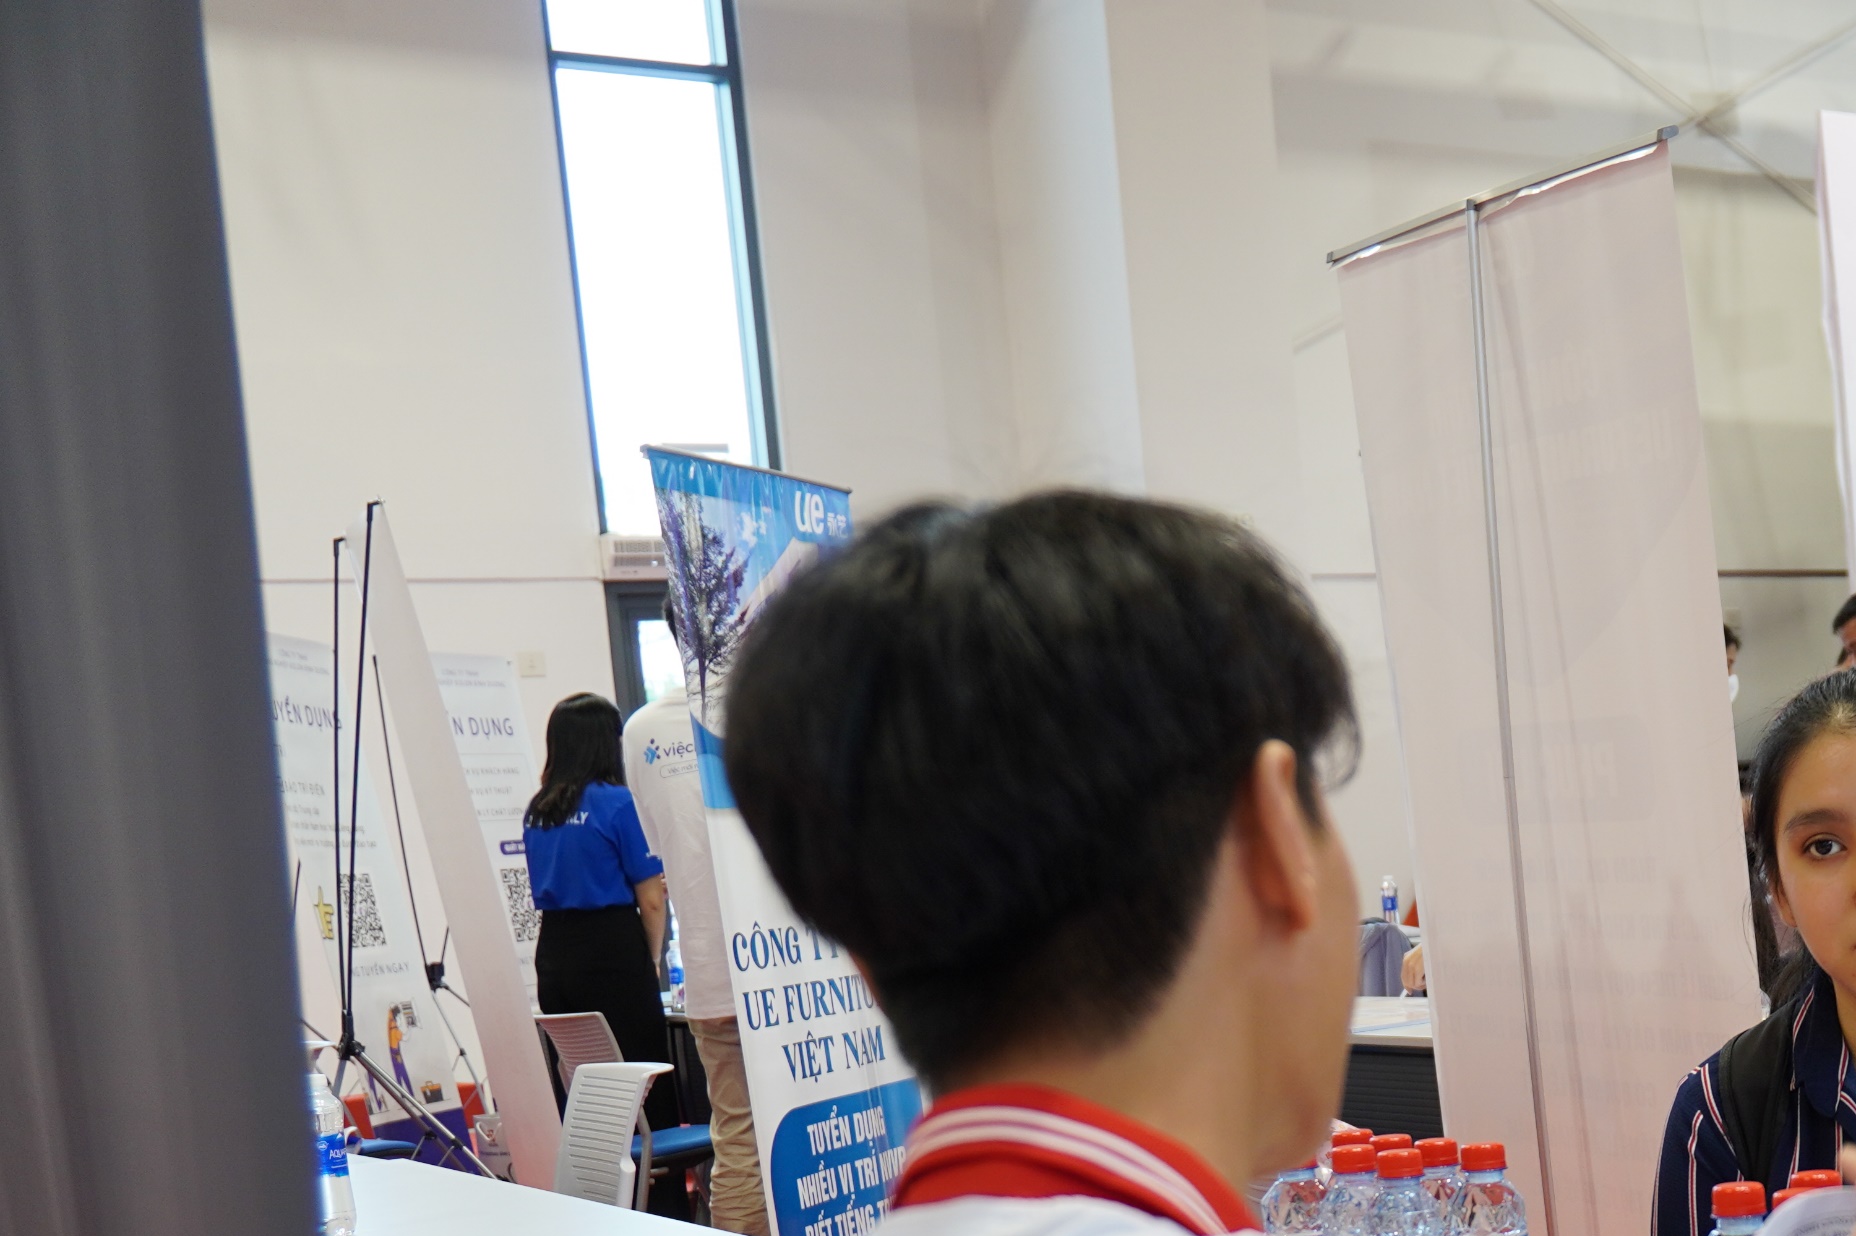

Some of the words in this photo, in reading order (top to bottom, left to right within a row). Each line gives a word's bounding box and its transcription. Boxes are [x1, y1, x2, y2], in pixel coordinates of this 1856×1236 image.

[468, 717, 515, 740] DỤNG
[732, 920, 802, 972] CÔNG
[742, 987, 780, 1031] UE
[781, 1030, 835, 1083] VIỆT
[841, 1024, 886, 1070] NAM
[806, 1104, 852, 1156] TUYỂN
[853, 1105, 886, 1147] DỤNG
[796, 1160, 839, 1210] NHIỀU
[838, 1162, 856, 1201] VỊ
[855, 1149, 880, 1190] TRÍ
